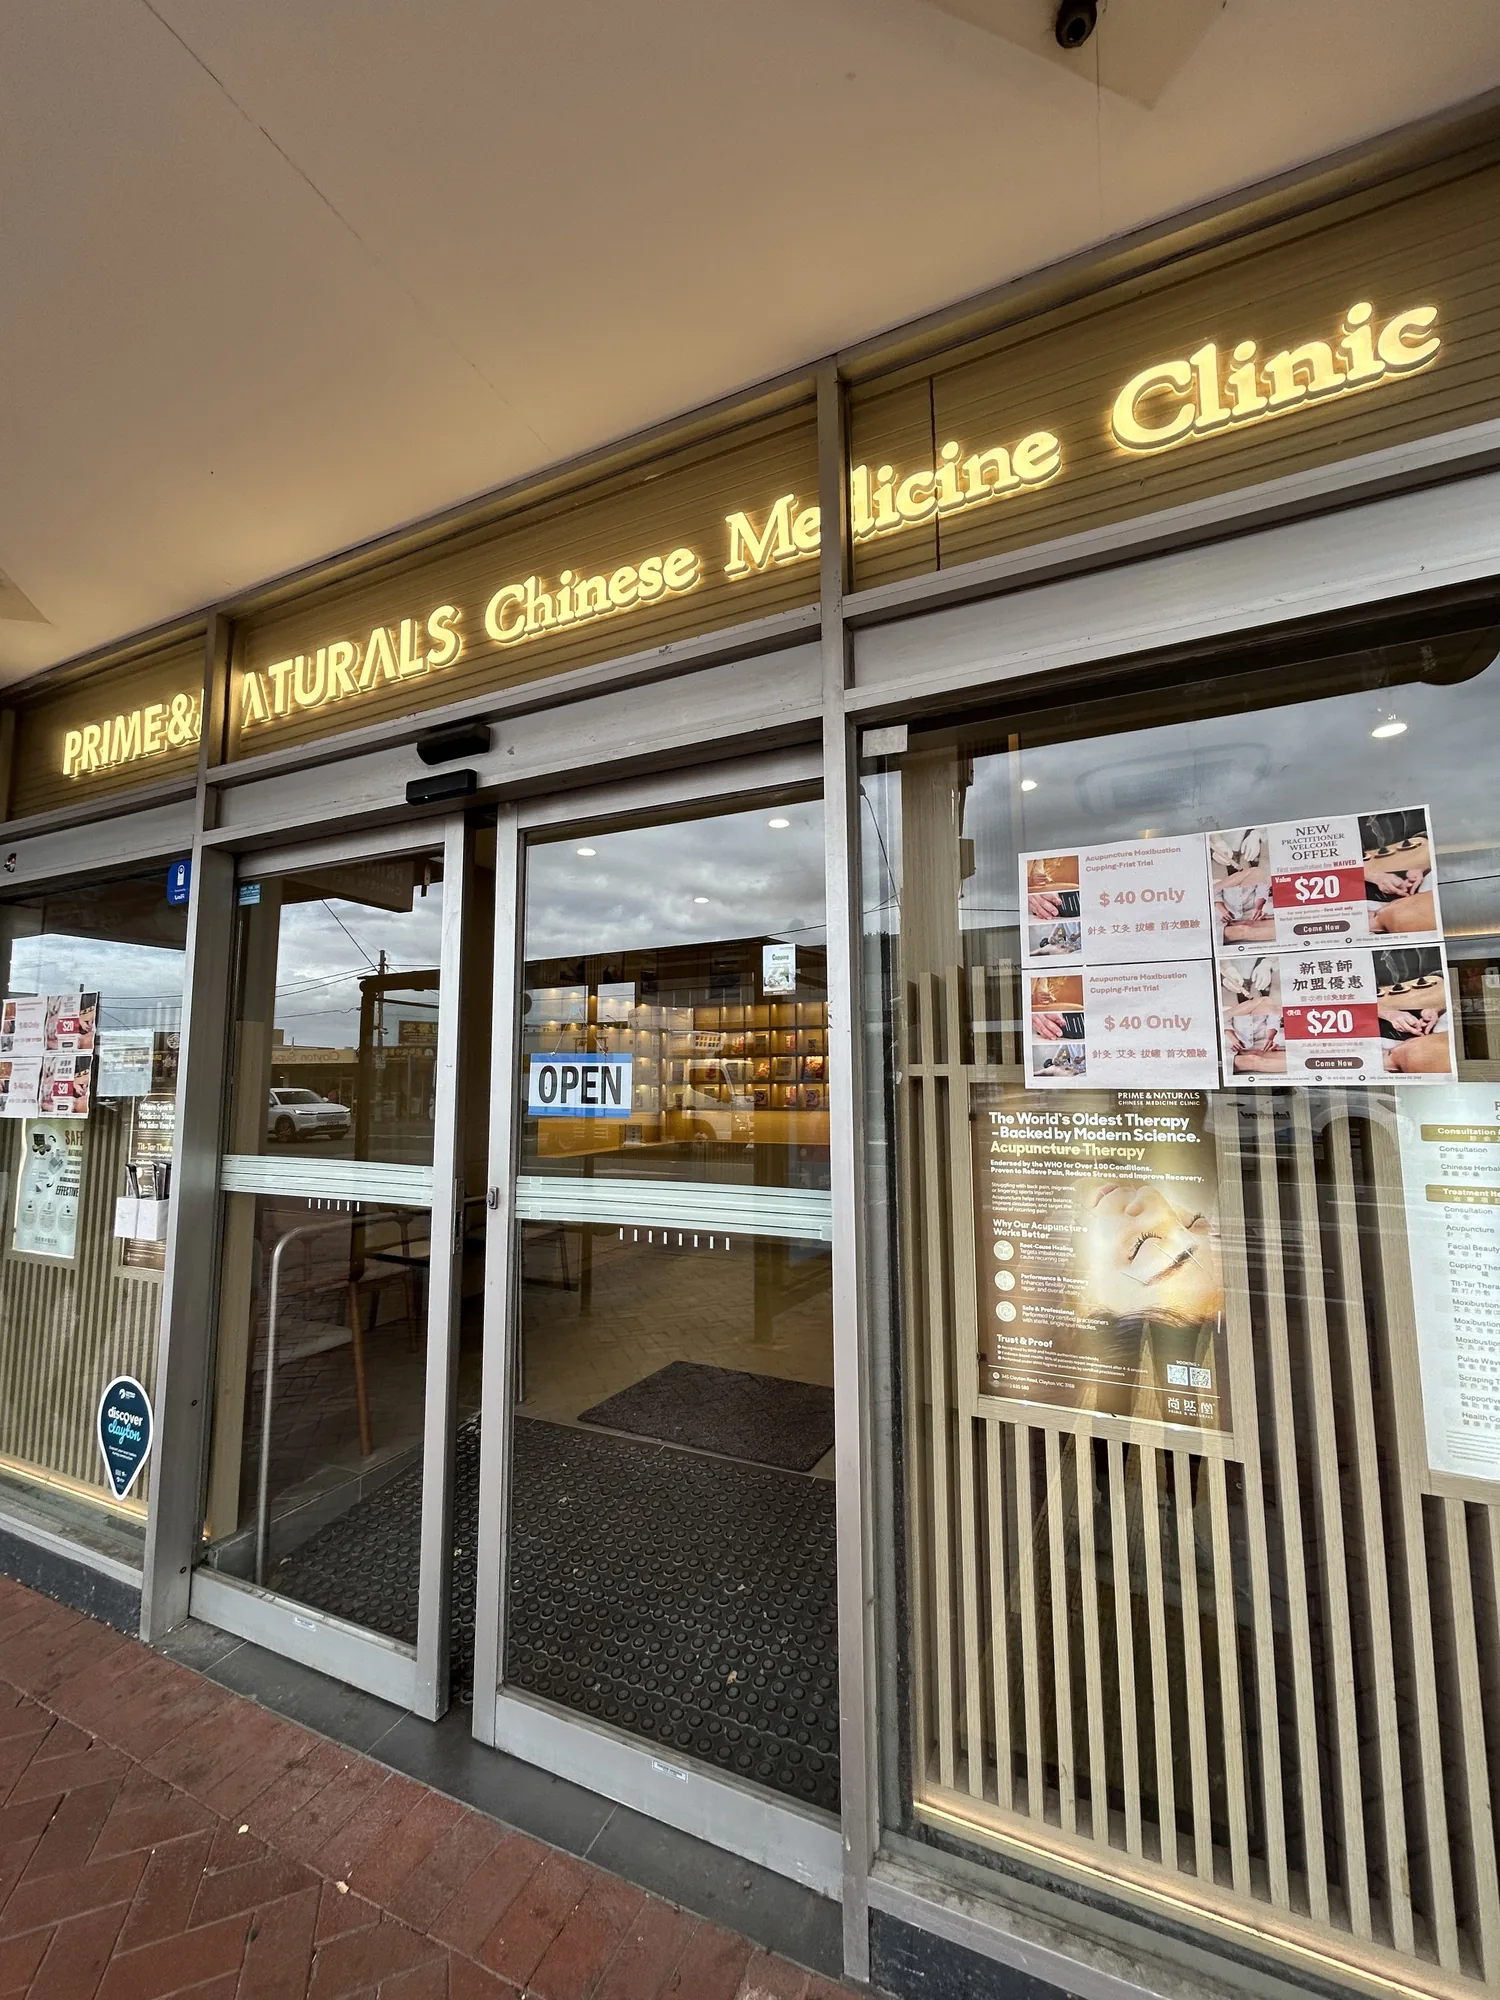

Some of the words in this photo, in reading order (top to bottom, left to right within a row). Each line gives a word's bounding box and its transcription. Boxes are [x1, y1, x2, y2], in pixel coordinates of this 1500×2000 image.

[200, 604, 463, 736] ATURALS
[484, 544, 701, 645] Chinese
[1111, 301, 1442, 453] Clinic
[1295, 824, 1330, 837] NEW
[1281, 833, 1345, 846] PRACTITIONER
[1289, 840, 1338, 851] WELCOME
[1085, 851, 1133, 862] Acupuncture
[1291, 847, 1340, 861] OFFER
[1333, 859, 1357, 867] WAIVED
[1274, 876, 1292, 884] Value
[1294, 875, 1340, 903] $20
[1114, 890, 1136, 905] 40
[1140, 887, 1185, 903] Only
[1087, 926, 1107, 936] 針灸
[1111, 924, 1131, 934] 艾灸
[1160, 919, 1200, 931] 首次體驗
[1299, 959, 1353, 975] 新醫師
[1089, 975, 1138, 983] Acupuncture
[1292, 975, 1364, 992] 加盟優惠
[1142, 984, 1160, 992] Trial
[62, 1020, 75, 1032] $20
[1119, 1016, 1142, 1030] 40
[1146, 1014, 1192, 1031] Only
[1306, 1008, 1354, 1037] $20
[1092, 1049, 1112, 1059] 針灸
[1116, 1049, 1136, 1059] 艾灸
[1166, 1048, 1208, 1058] 首次體驗
[1337, 1059, 1353, 1067] Now
[57, 1082, 69, 1095] $20
[538, 1065, 622, 1105] OPEN
[140, 1102, 156, 1111] Where
[156, 1103, 174, 1112] Sports
[138, 1111, 161, 1120] Medicine
[988, 1111, 1015, 1125] The
[1016, 1111, 1071, 1125] World's
[1072, 1112, 1123, 1126] Oldest
[1124, 1113, 1190, 1131] Therapy
[138, 1121, 147, 1129] We
[146, 1121, 159, 1129] Take
[64, 1129, 85, 1146] SAFE
[1054, 1126, 1072, 1143] by
[1073, 1127, 1131, 1141] Modern
[1133, 1128, 1201, 1143] Science.
[1437, 1127, 1496, 1136] Consultation
[990, 1140, 1081, 1157] Acupuncture
[1082, 1142, 1146, 1161] Therapy
[1439, 1145, 1488, 1153] Consultation
[990, 1159, 1022, 1167] Endorsed
[1022, 1160, 1031, 1168] by
[1031, 1160, 1043, 1168] the
[1074, 1162, 1093, 1170] Over
[1093, 1162, 1108, 1170] 100
[1108, 1163, 1153, 1172] Conditions.
[1440, 1163, 1473, 1171] Chinese
[990, 1166, 1014, 1174] Proven
[1047, 1168, 1065, 1176] Pain,
[1065, 1169, 1092, 1177] Reduce
[1092, 1170, 1118, 1179] Stress,
[1118, 1171, 1133, 1179] and
[1133, 1172, 1165, 1181] Improve
[1165, 1173, 1205, 1183] Recovery.
[1443, 1187, 1489, 1197] Treatment
[1443, 1205, 1493, 1215] Consultation
[992, 1218, 1013, 1229] Why
[1013, 1220, 1030, 1229] Our
[1031, 1221, 1088, 1233] Acupuncture
[1445, 1224, 1495, 1234] Acupuncture
[992, 1227, 1021, 1237] Works
[1021, 1229, 1050, 1239] Better
[1051, 1245, 1074, 1253] Healing
[1447, 1242, 1471, 1251] Facial
[1472, 1244, 1500, 1254] Beauty
[1448, 1261, 1482, 1271] Cupping
[1020, 1273, 1056, 1281] Performance
[1062, 1276, 1089, 1286] Recovery
[1040, 1306, 1075, 1316] Professional
[996, 1333, 1019, 1344] Trust
[1019, 1336, 1028, 1346] &
[1027, 1337, 1053, 1349] Proof
[1457, 1354, 1479, 1364] Pulse
[1458, 1373, 1494, 1386] Scraping
[108, 1405, 144, 1427] discover
[1462, 1411, 1488, 1421] Health
